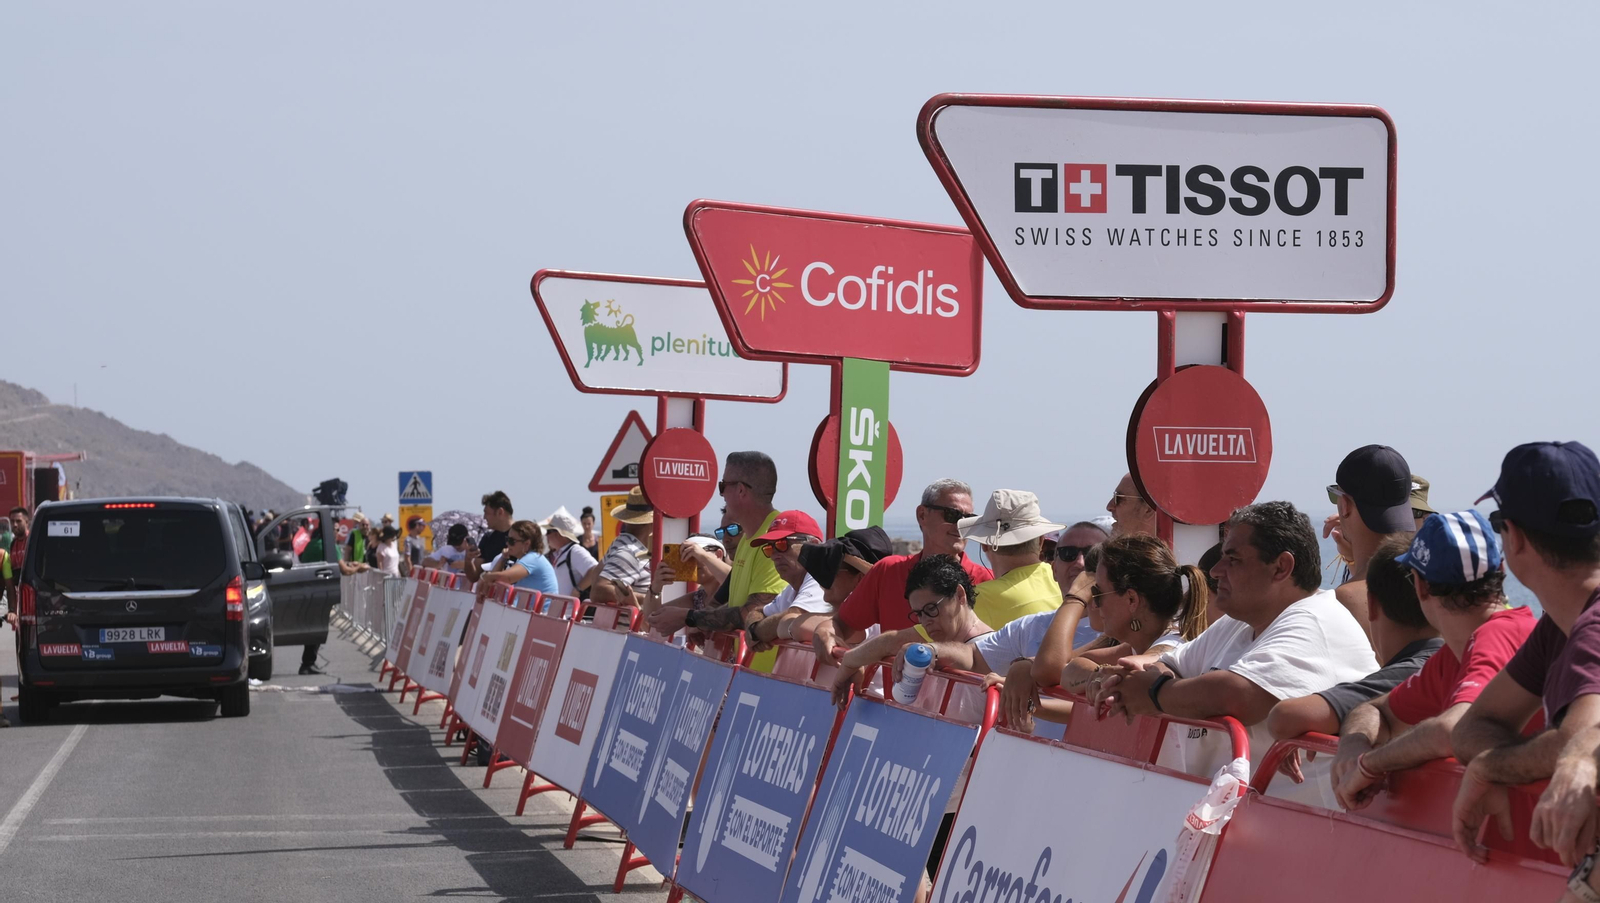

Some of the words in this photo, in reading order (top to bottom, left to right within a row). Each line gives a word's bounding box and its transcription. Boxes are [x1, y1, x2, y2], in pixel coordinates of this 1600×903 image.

[1115, 164, 1364, 216] TISSOT
[1014, 227, 1093, 247] SWISS
[1107, 228, 1219, 248] WATCHES
[1232, 228, 1302, 248] SINCE
[1316, 230, 1365, 249] 1853
[800, 261, 960, 318] Cofidis
[650, 331, 740, 358] plenitu
[1164, 433, 1184, 455] LA
[1186, 433, 1247, 456] VUELTA
[660, 461, 671, 475] LA
[672, 462, 705, 477] VUELTA
[845, 406, 880, 530] ŠKO
[64, 526, 73, 534] 61
[52, 644, 78, 654] VUELTA
[106, 630, 136, 641] 9928
[139, 628, 162, 640] LRK
[160, 642, 186, 652] VUELTA
[742, 715, 816, 794] LOTERÍAS
[854, 754, 941, 848] LOTERÍAS
[728, 808, 747, 839] CON
[748, 817, 783, 857] DEPORTE
[939, 825, 1085, 903] Carrf
[837, 863, 860, 900] CON
